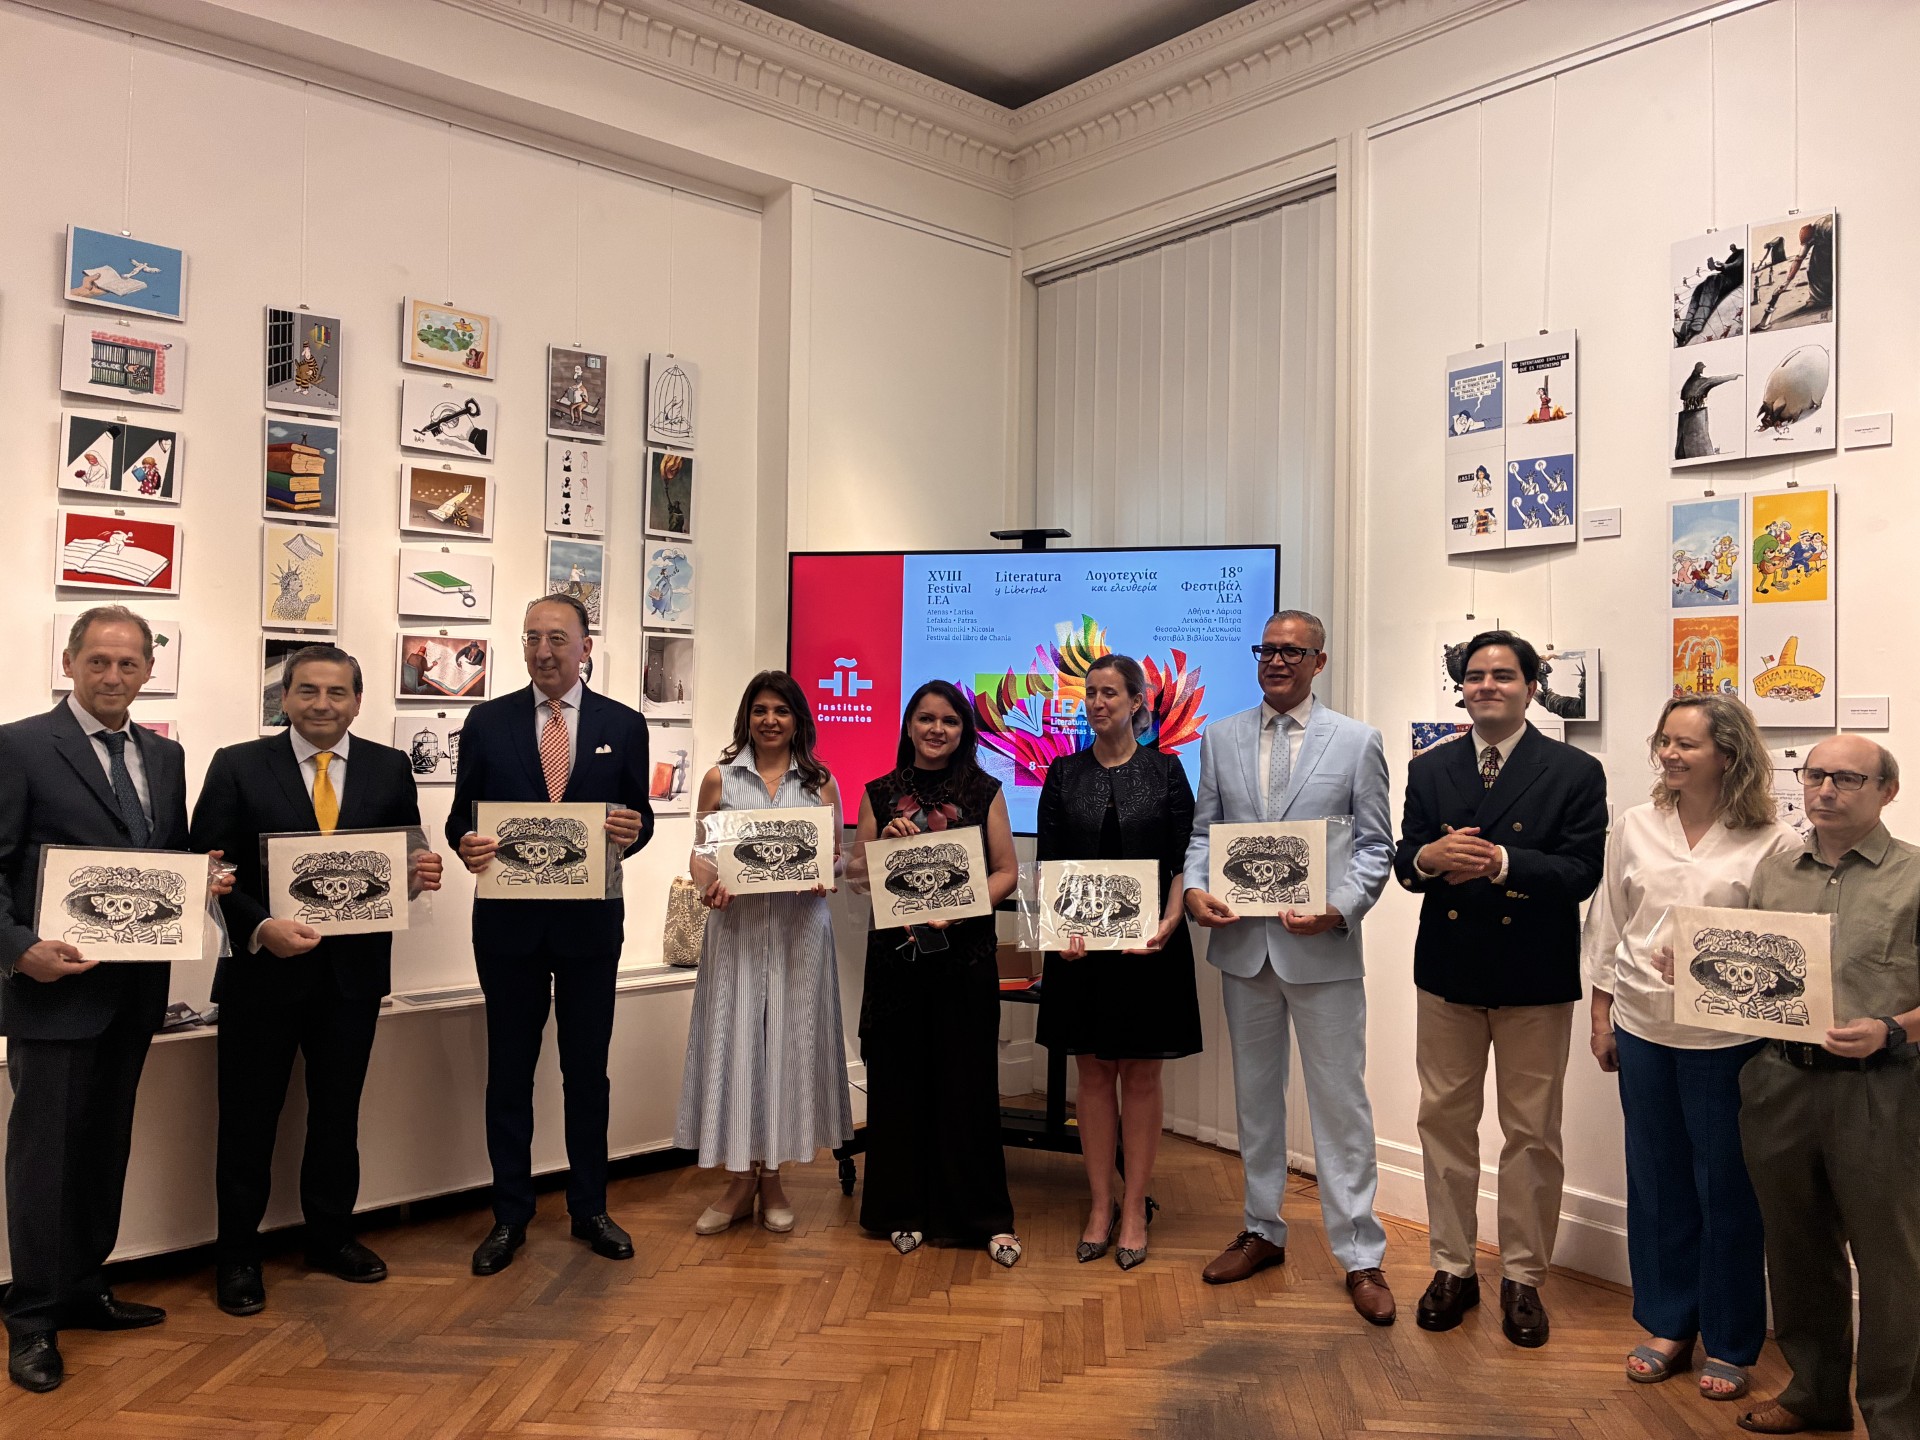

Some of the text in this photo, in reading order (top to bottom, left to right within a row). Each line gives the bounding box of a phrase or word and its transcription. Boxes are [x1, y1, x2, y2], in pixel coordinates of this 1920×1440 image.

[928, 570, 962, 582] XVIII
[995, 571, 1062, 582] Literatura
[1085, 569, 1158, 583] Λογοτεχνία
[927, 583, 972, 593] Festival
[995, 586, 1048, 596] y Libertad
[1091, 582, 1158, 593] και ελευθερία
[1181, 580, 1242, 593] Φεστιβάλ
[927, 595, 950, 605] LEA
[1187, 607, 1242, 616] Αθήνα Λάρισα
[1181, 616, 1242, 625] Λευκάδα Πάτρα
[1155, 625, 1241, 634] Θεσσαλονίκη Λευκωσία
[1153, 634, 1184, 642] Φεστιβάλ
[1186, 634, 1213, 642] Βιβλίου
[818, 702, 872, 711] Instituto
[1051, 698, 1087, 718] LEA
[817, 714, 872, 723] Cervantes
[1051, 717, 1087, 726] Literatura
[1061, 727, 1087, 735] Atenas
